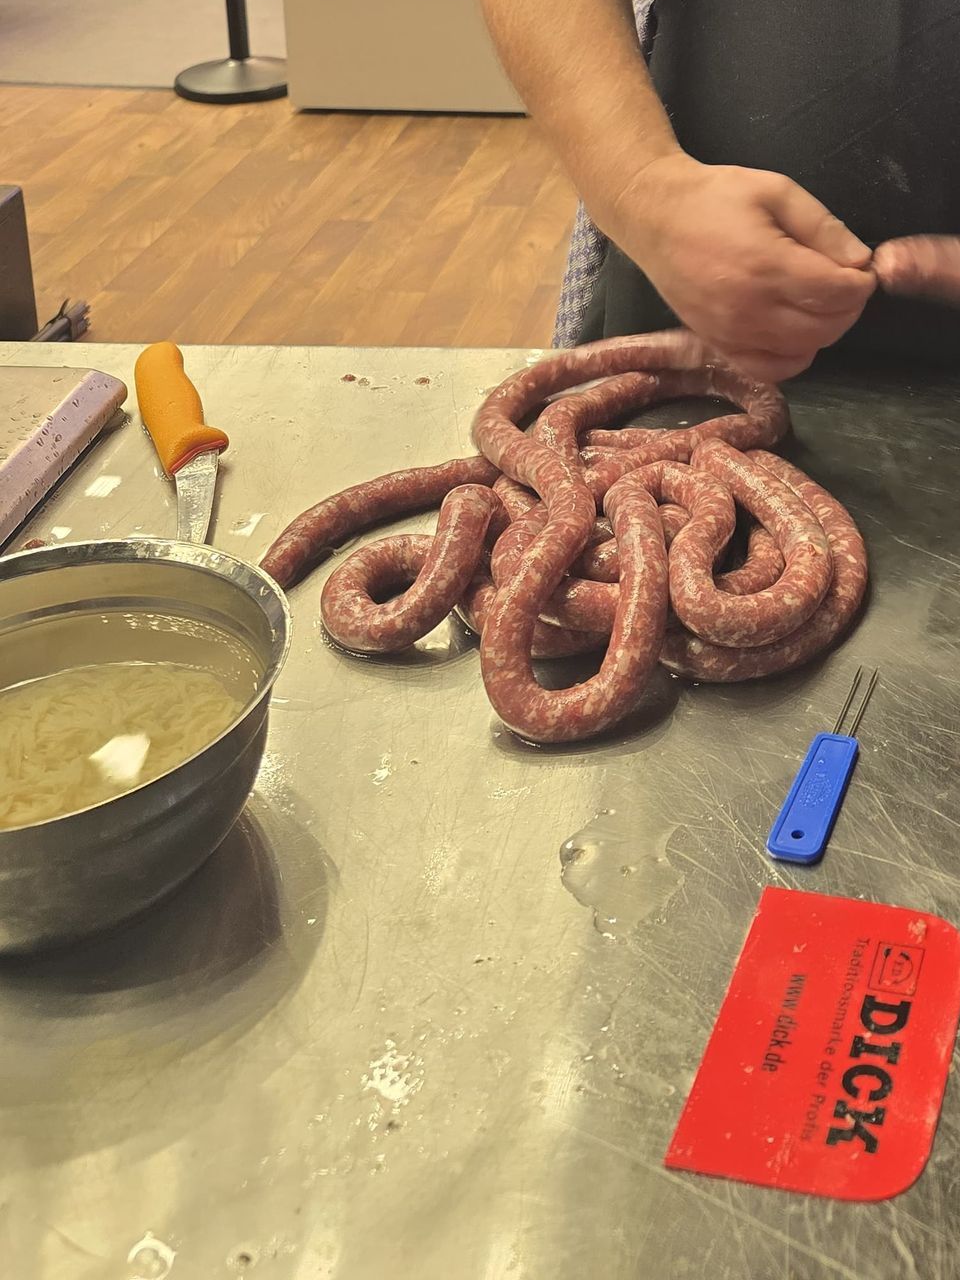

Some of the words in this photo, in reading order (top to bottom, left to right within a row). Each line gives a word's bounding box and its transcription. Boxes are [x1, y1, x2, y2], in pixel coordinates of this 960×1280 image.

[761, 973, 807, 1073] www.dick.de
[824, 937, 871, 1055] Traditionsmarke
[817, 1061, 834, 1088] der
[825, 994, 912, 1154] DICK
